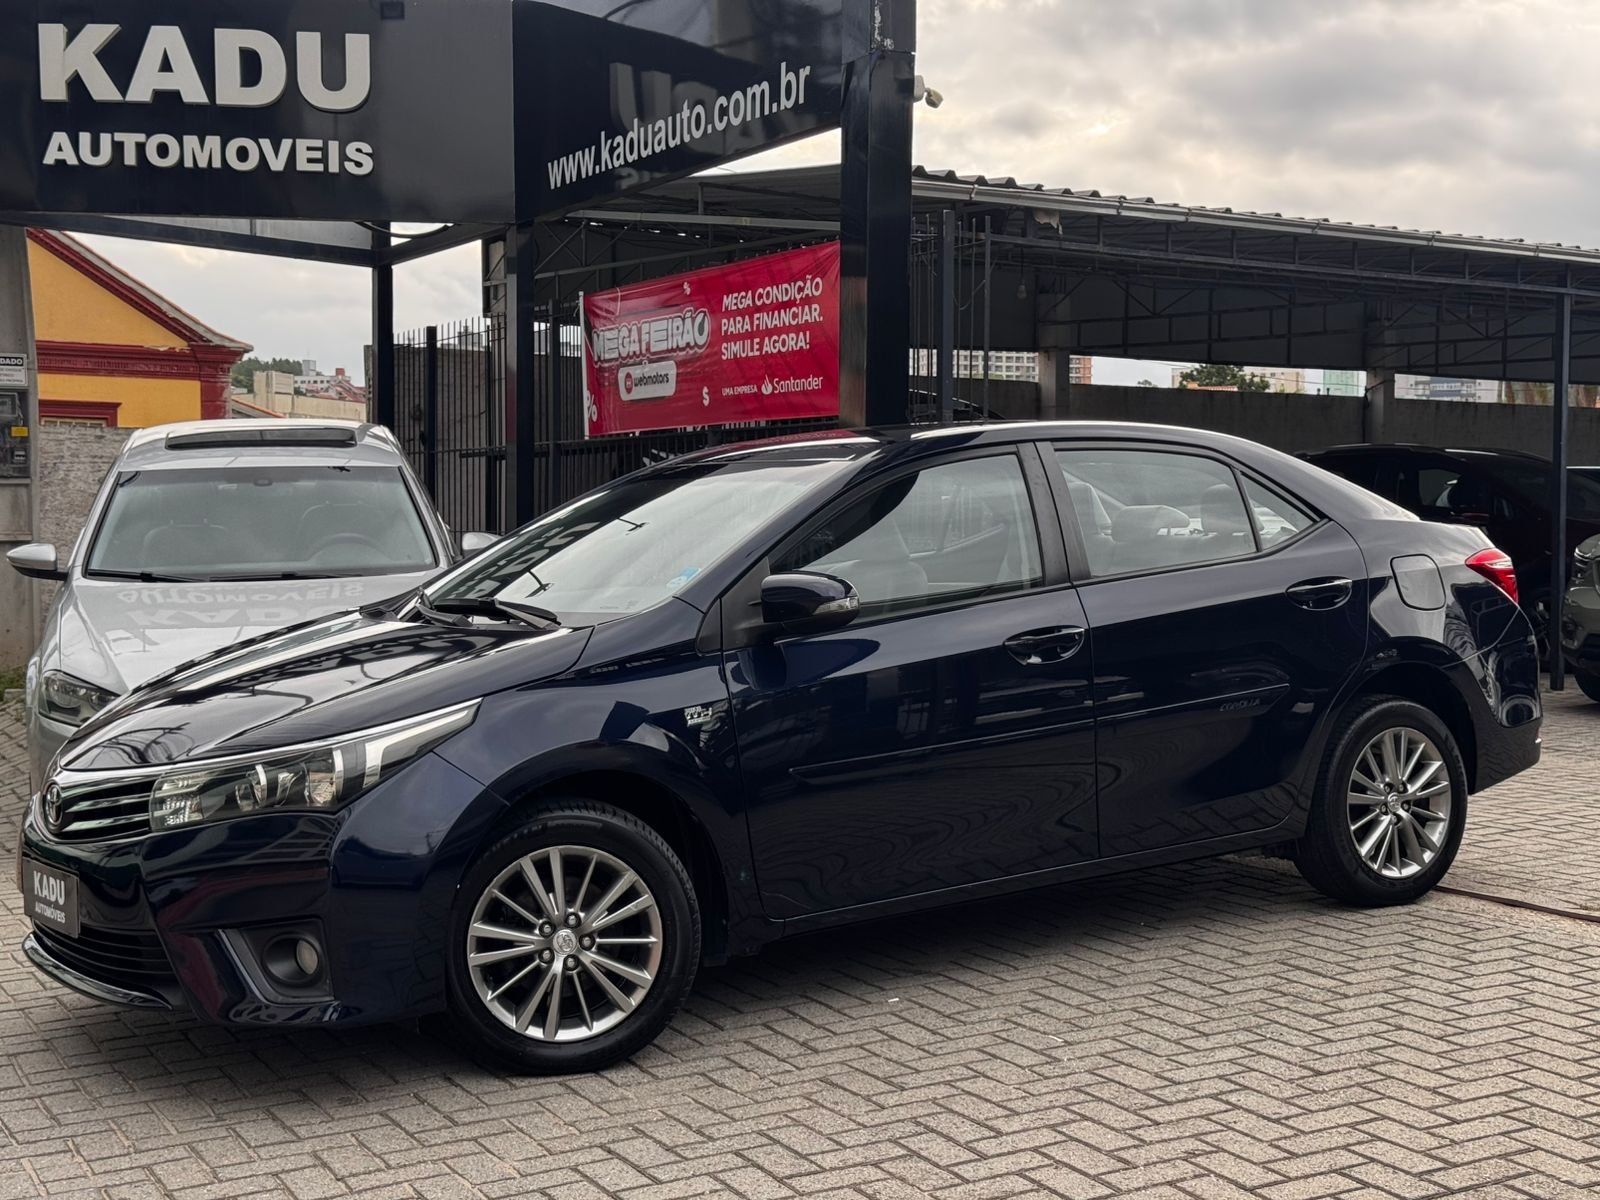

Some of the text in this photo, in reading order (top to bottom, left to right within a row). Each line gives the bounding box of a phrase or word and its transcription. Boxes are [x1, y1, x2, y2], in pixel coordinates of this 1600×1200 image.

[38, 23, 371, 112] KADU
[547, 61, 811, 190] www.kaduauto.com.br
[42, 131, 375, 175] AUTOMOVEIS
[722, 275, 823, 312] MEGA CONDIÇÃO
[721, 303, 823, 336] PARA FINANCIAR.
[721, 330, 810, 360] SIMULE AGORA!
[634, 373, 669, 387] webmotors
[722, 374, 823, 396] UMA EMPRESA Santander
[33, 870, 65, 905] KADU
